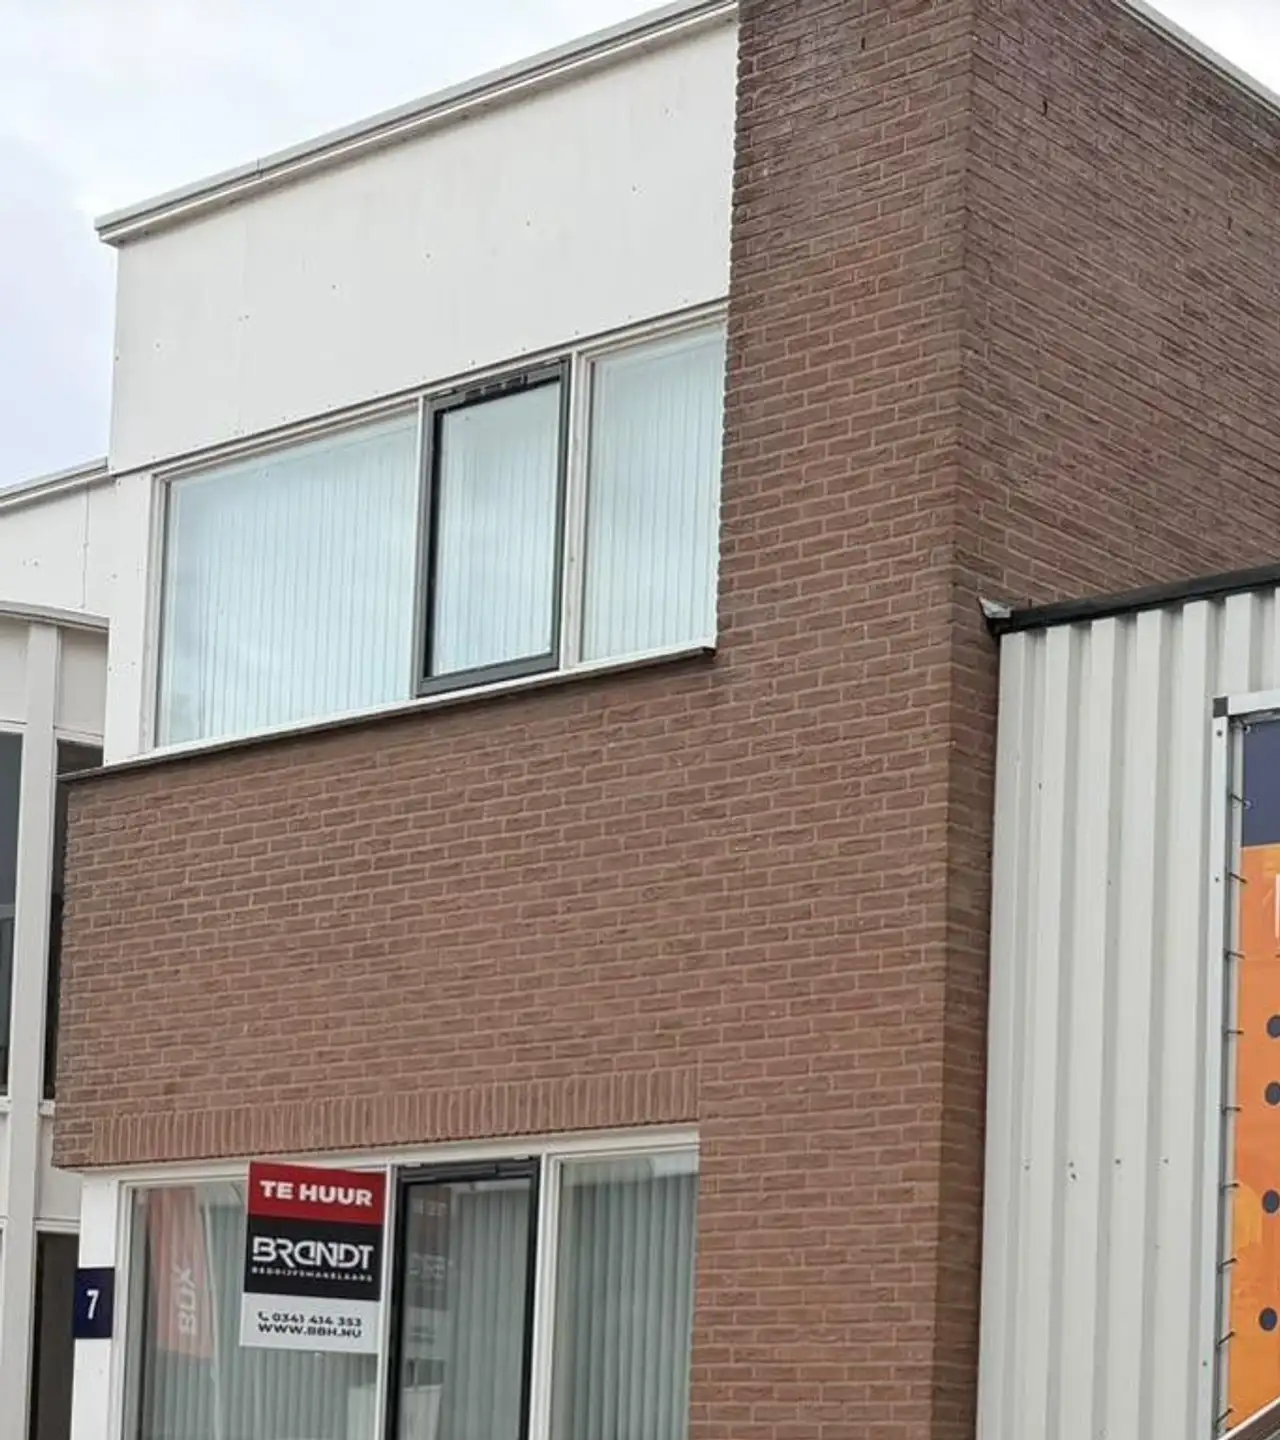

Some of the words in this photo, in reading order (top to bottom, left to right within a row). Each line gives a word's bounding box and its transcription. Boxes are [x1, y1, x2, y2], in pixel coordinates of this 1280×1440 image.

[259, 1180, 294, 1200] TE
[299, 1184, 373, 1207] HUUR
[252, 1236, 374, 1270] BRANDT
[87, 1289, 100, 1320] 7
